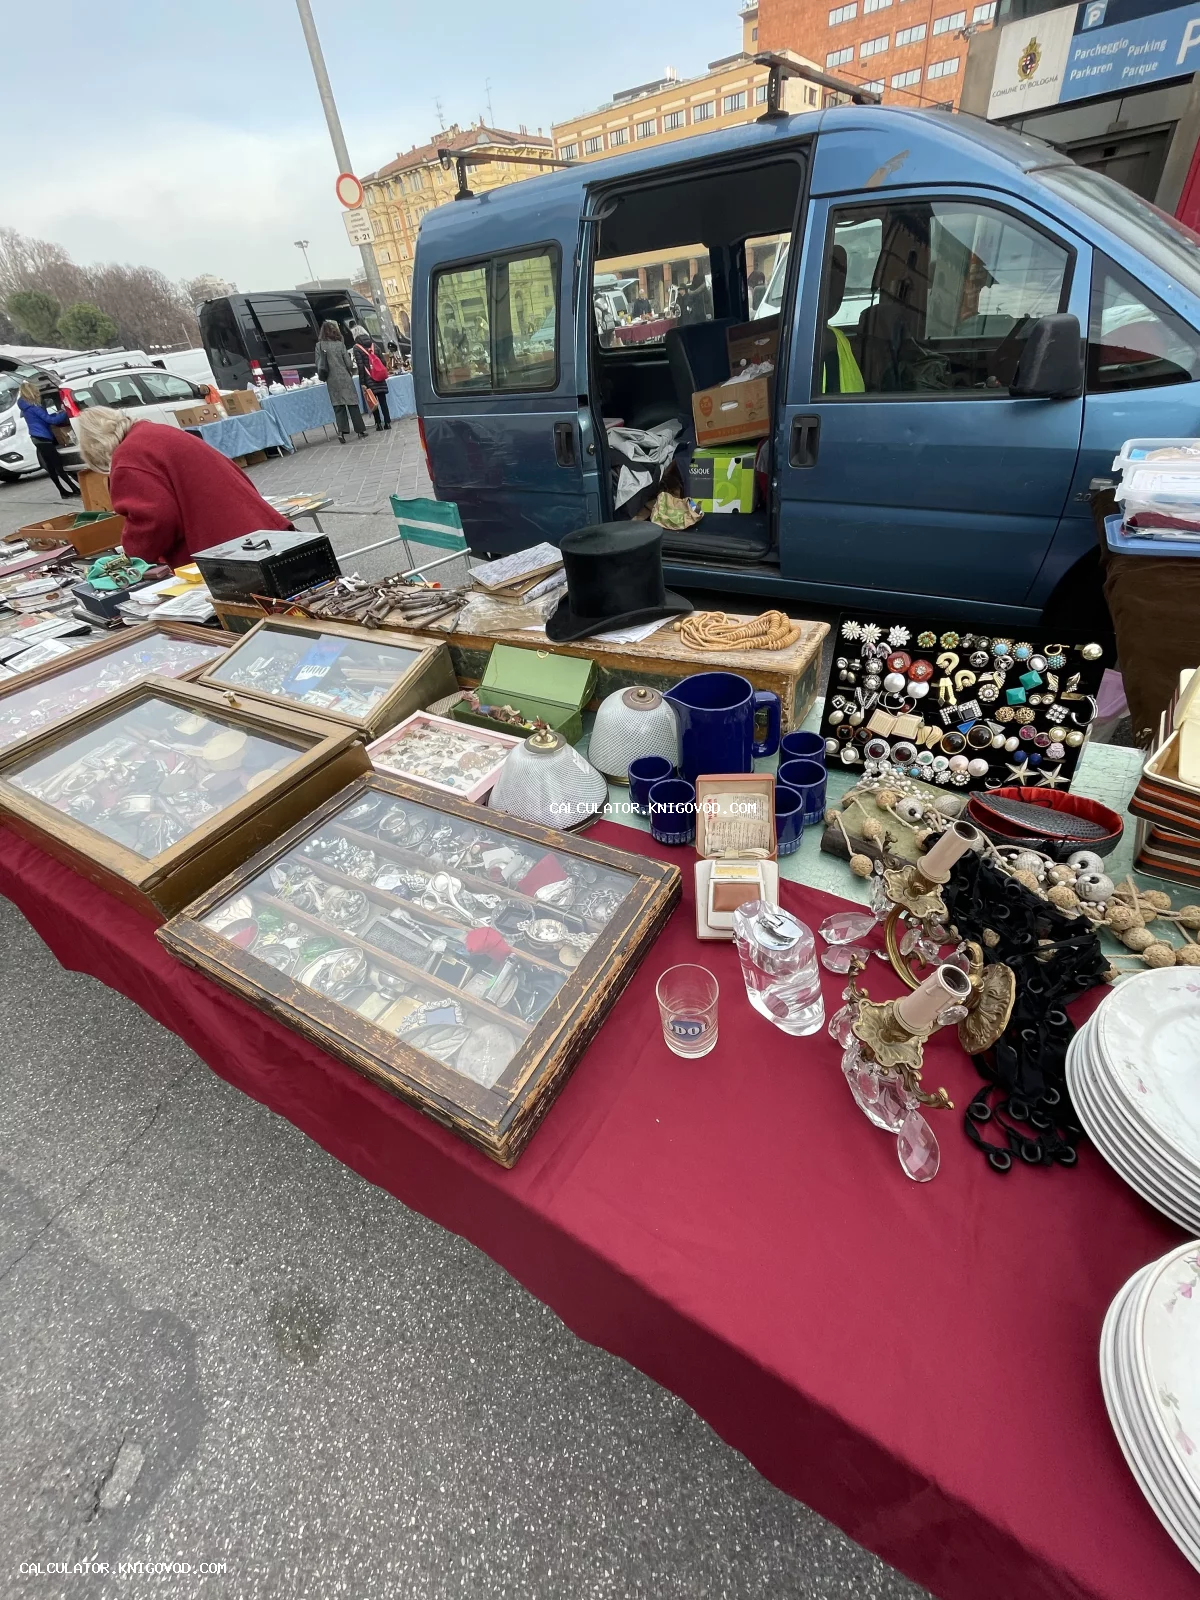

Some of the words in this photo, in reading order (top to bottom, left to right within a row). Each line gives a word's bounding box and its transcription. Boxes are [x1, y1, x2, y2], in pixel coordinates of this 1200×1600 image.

[1074, 38, 1129, 61] Parcheggio
[1127, 38, 1167, 57] Parking
[1069, 62, 1113, 80] Parkaren
[1121, 62, 1158, 78] Parque
[992, 84, 1017, 97] COMUNE
[1027, 74, 1059, 89] BOLOGNA
